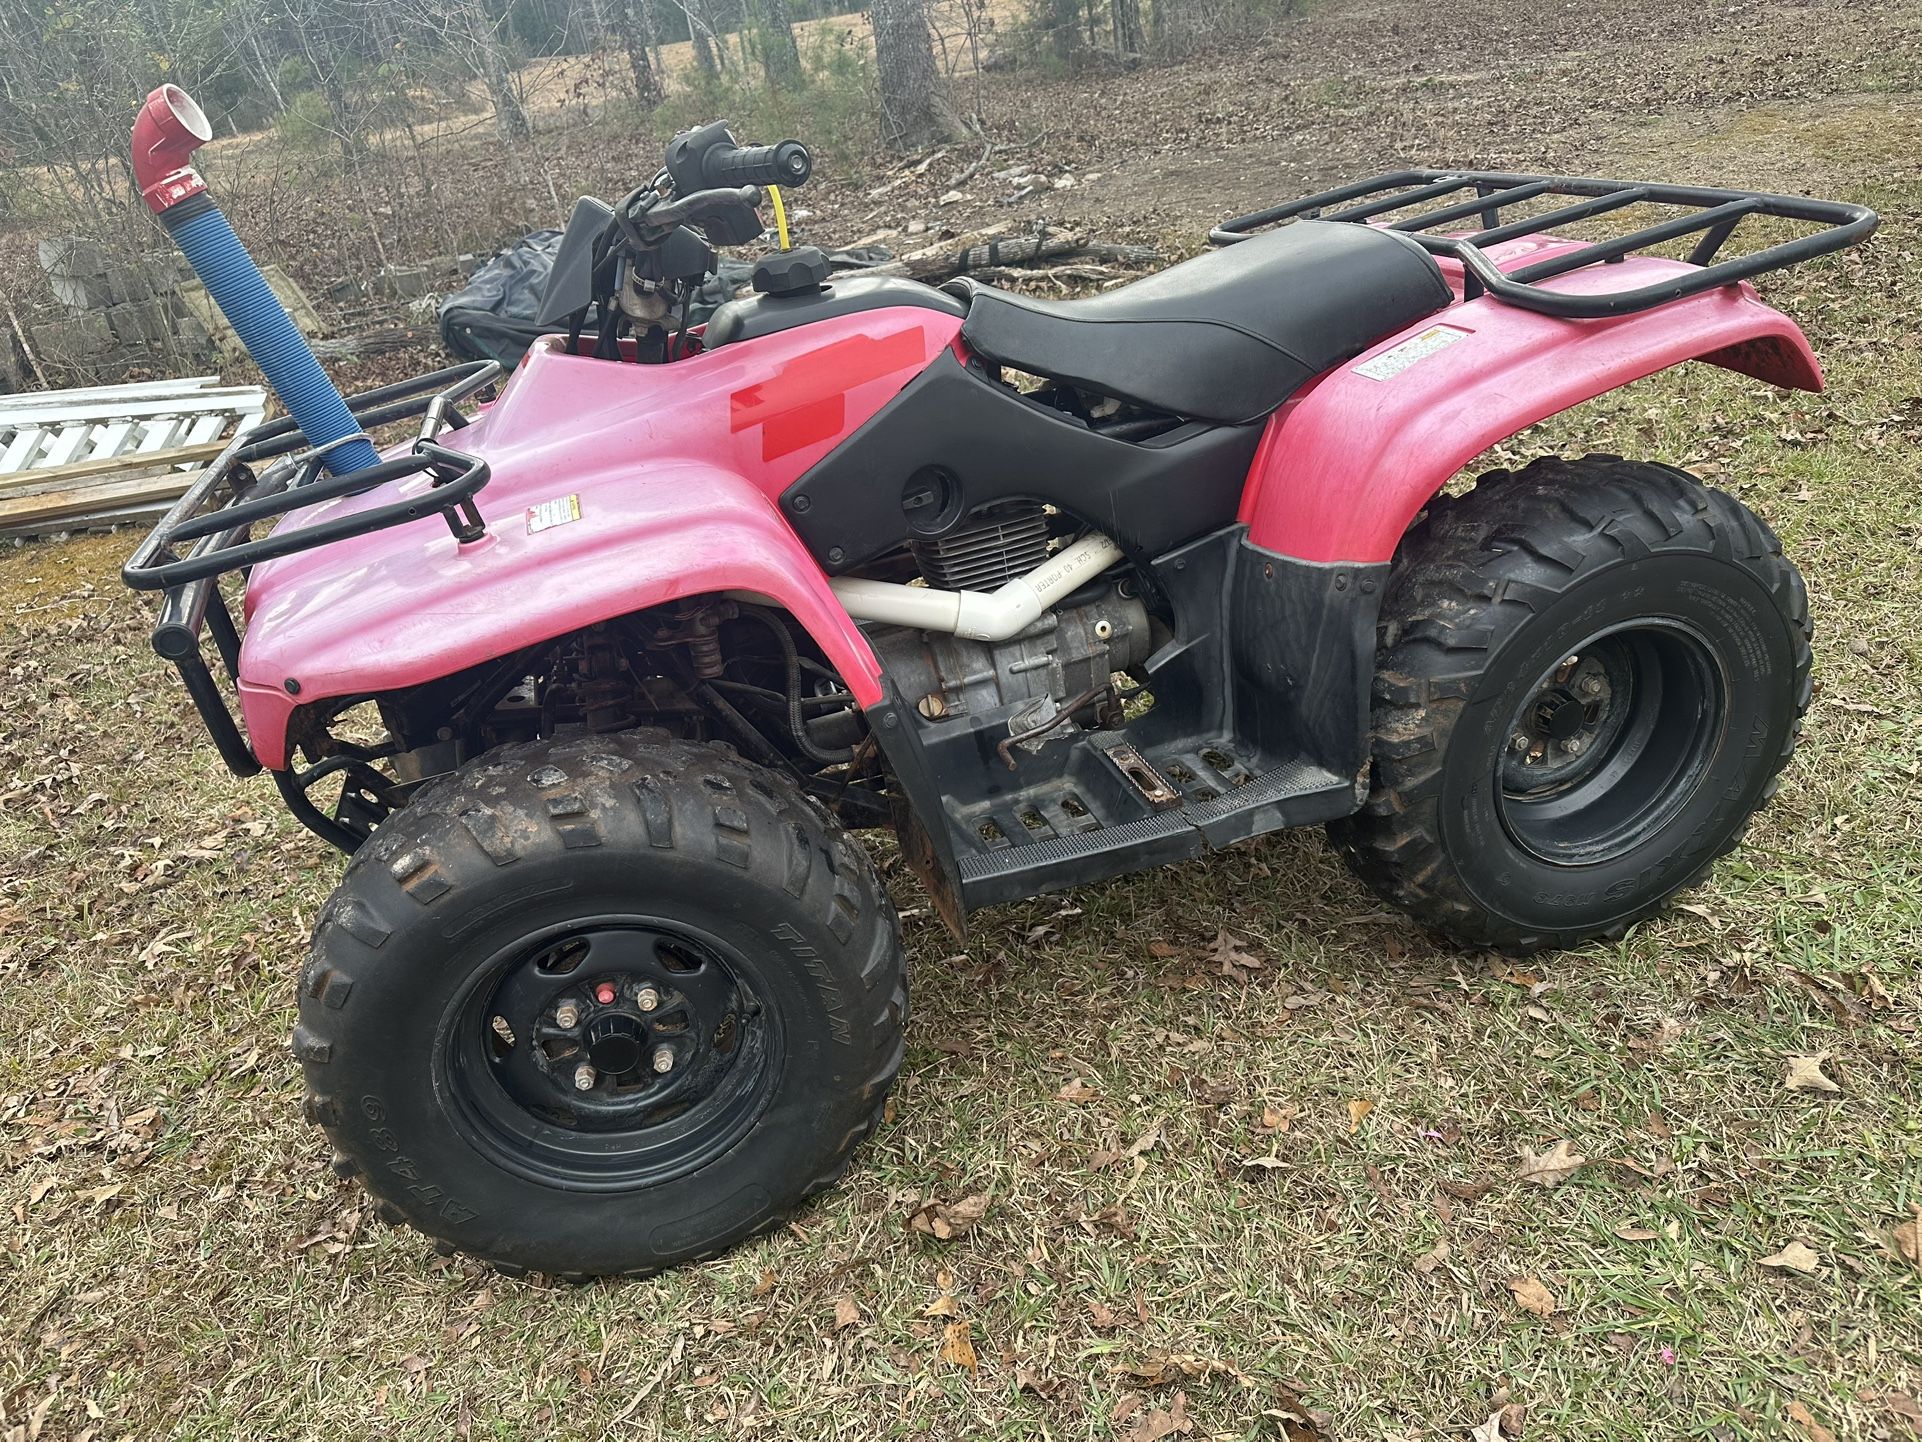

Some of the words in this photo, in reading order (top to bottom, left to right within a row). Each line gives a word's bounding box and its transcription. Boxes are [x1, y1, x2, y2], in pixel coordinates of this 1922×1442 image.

[1034, 571, 1065, 593] PORTER
[1063, 563, 1074, 574] 40
[770, 922, 851, 1046] TITAN
[360, 1094, 480, 1225] AT489
